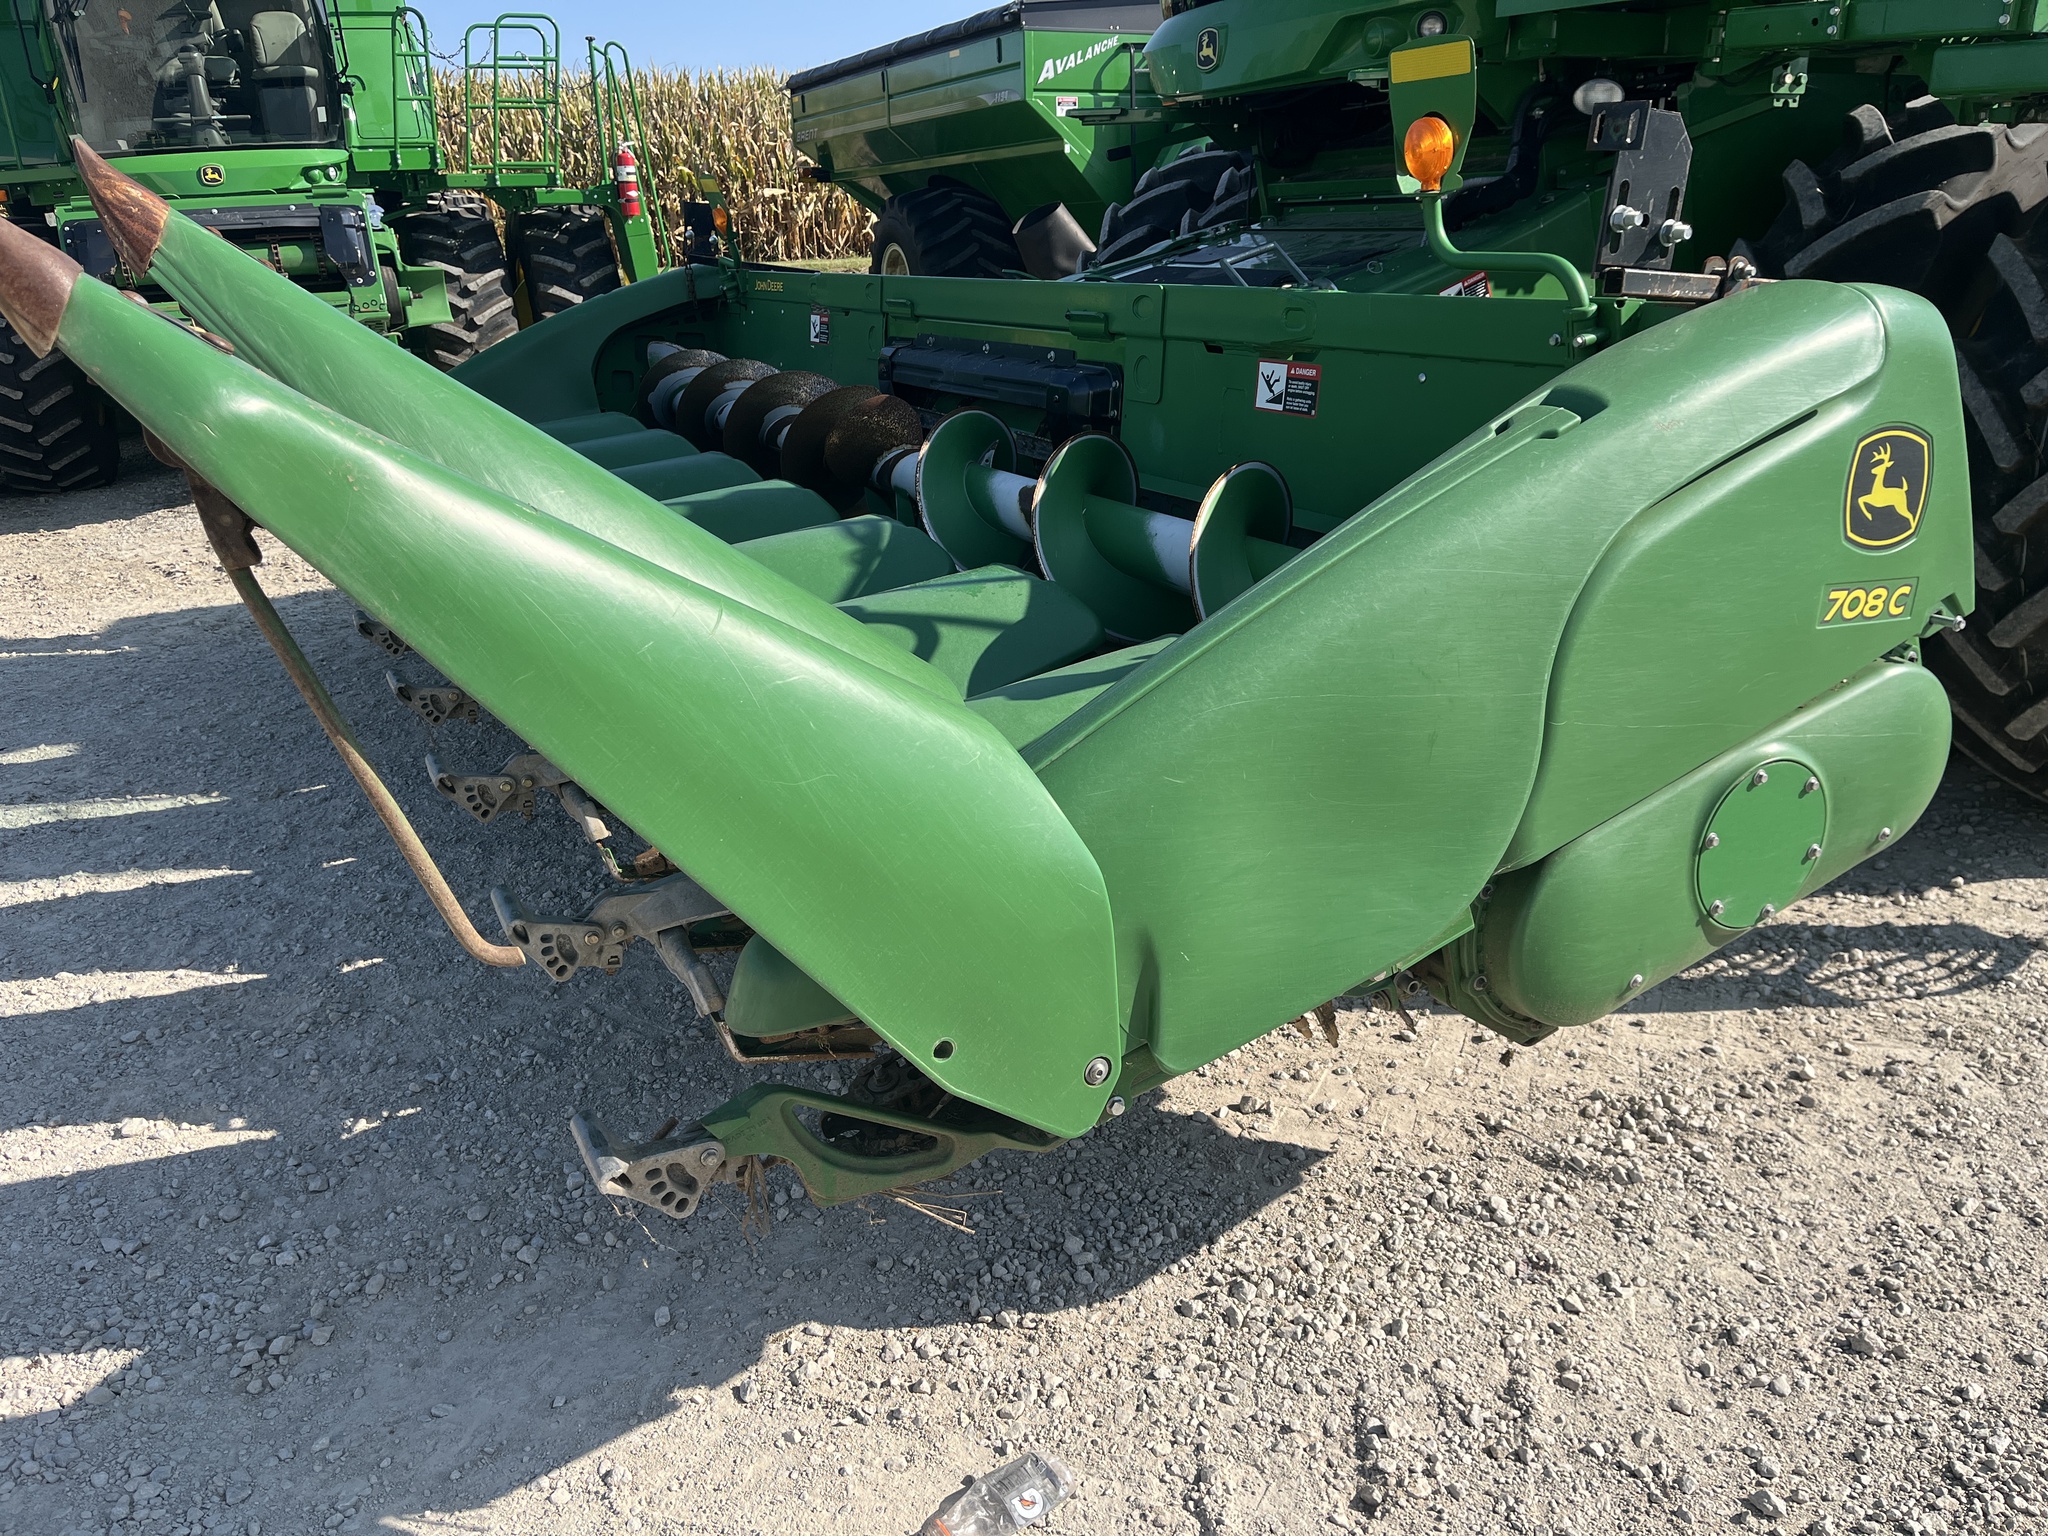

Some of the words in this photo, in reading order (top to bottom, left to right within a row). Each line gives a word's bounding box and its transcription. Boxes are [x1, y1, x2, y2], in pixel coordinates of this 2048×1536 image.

[1037, 35, 1119, 85] AVALANCHE
[796, 128, 818, 143] BRENT
[1295, 367, 1317, 376] DANGER
